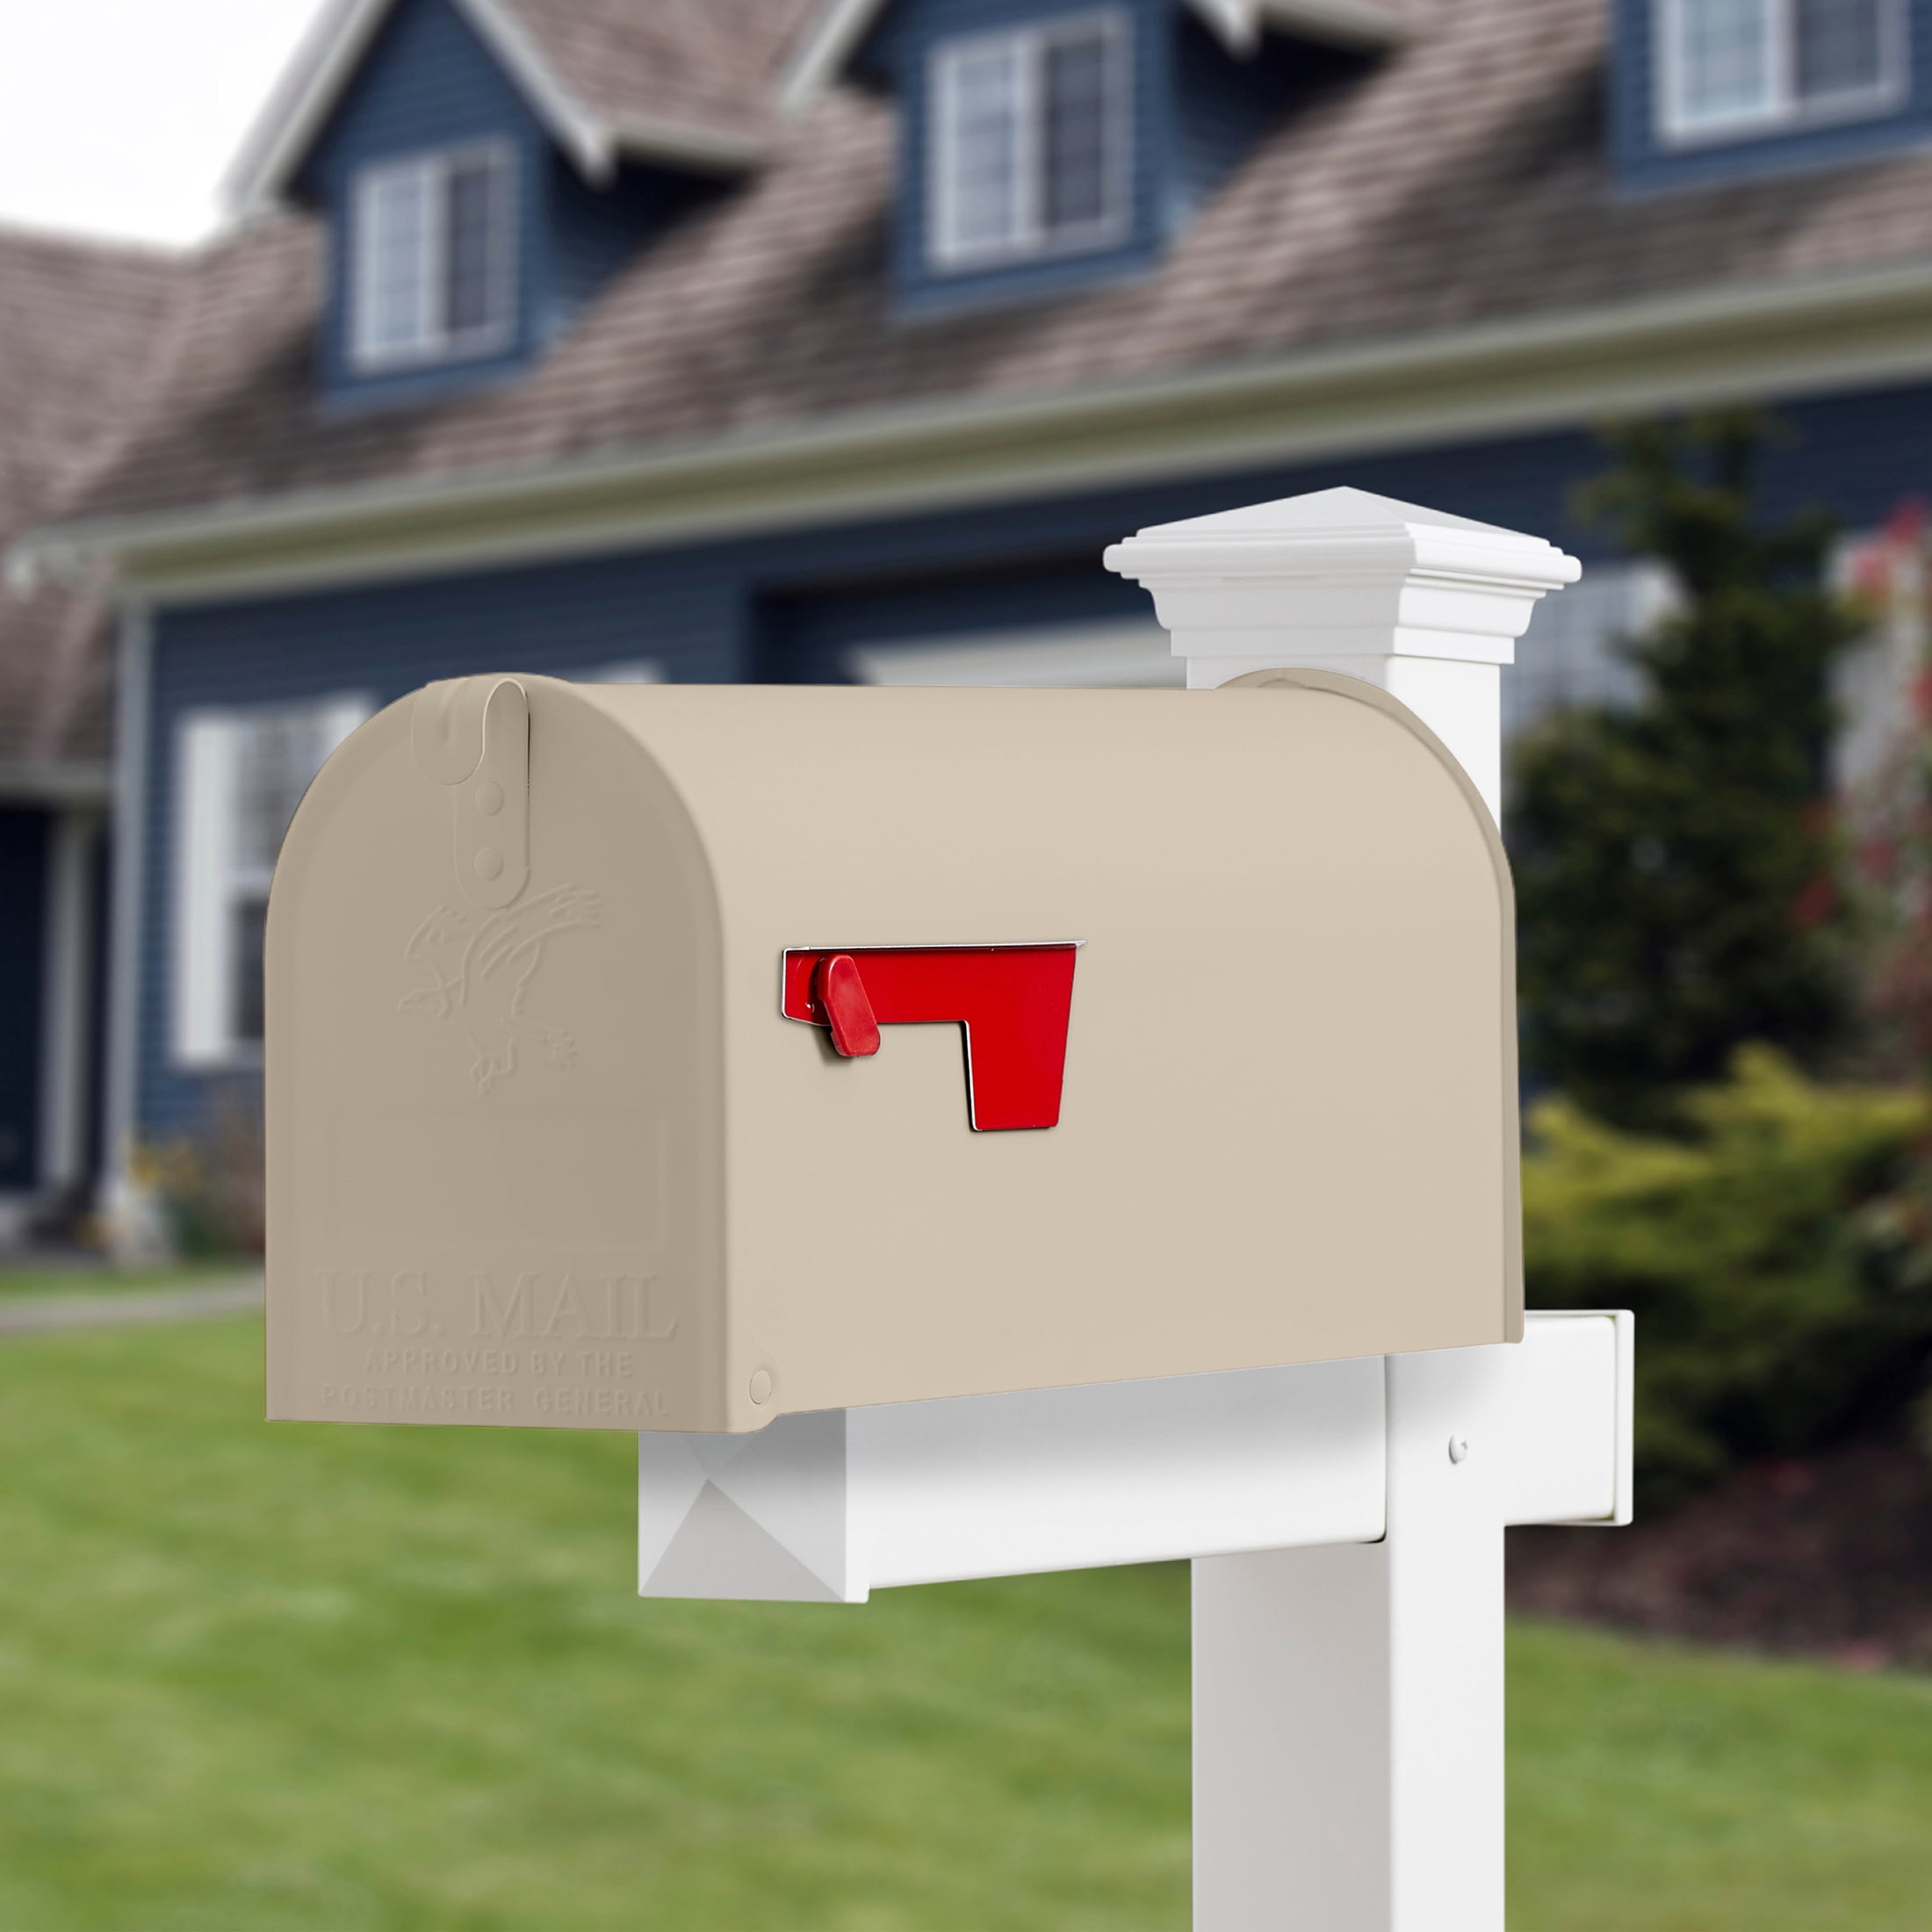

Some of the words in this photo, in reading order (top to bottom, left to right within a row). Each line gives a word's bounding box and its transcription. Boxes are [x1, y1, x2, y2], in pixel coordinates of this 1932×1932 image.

[316, 1266, 447, 1337] U.S.
[467, 1267, 678, 1342] MAIL
[364, 1347, 519, 1375] APPROVED
[530, 1350, 565, 1376] BY
[578, 1351, 634, 1378] THE
[321, 1382, 514, 1412] POSTMASTER
[535, 1388, 671, 1416] GENERAL
